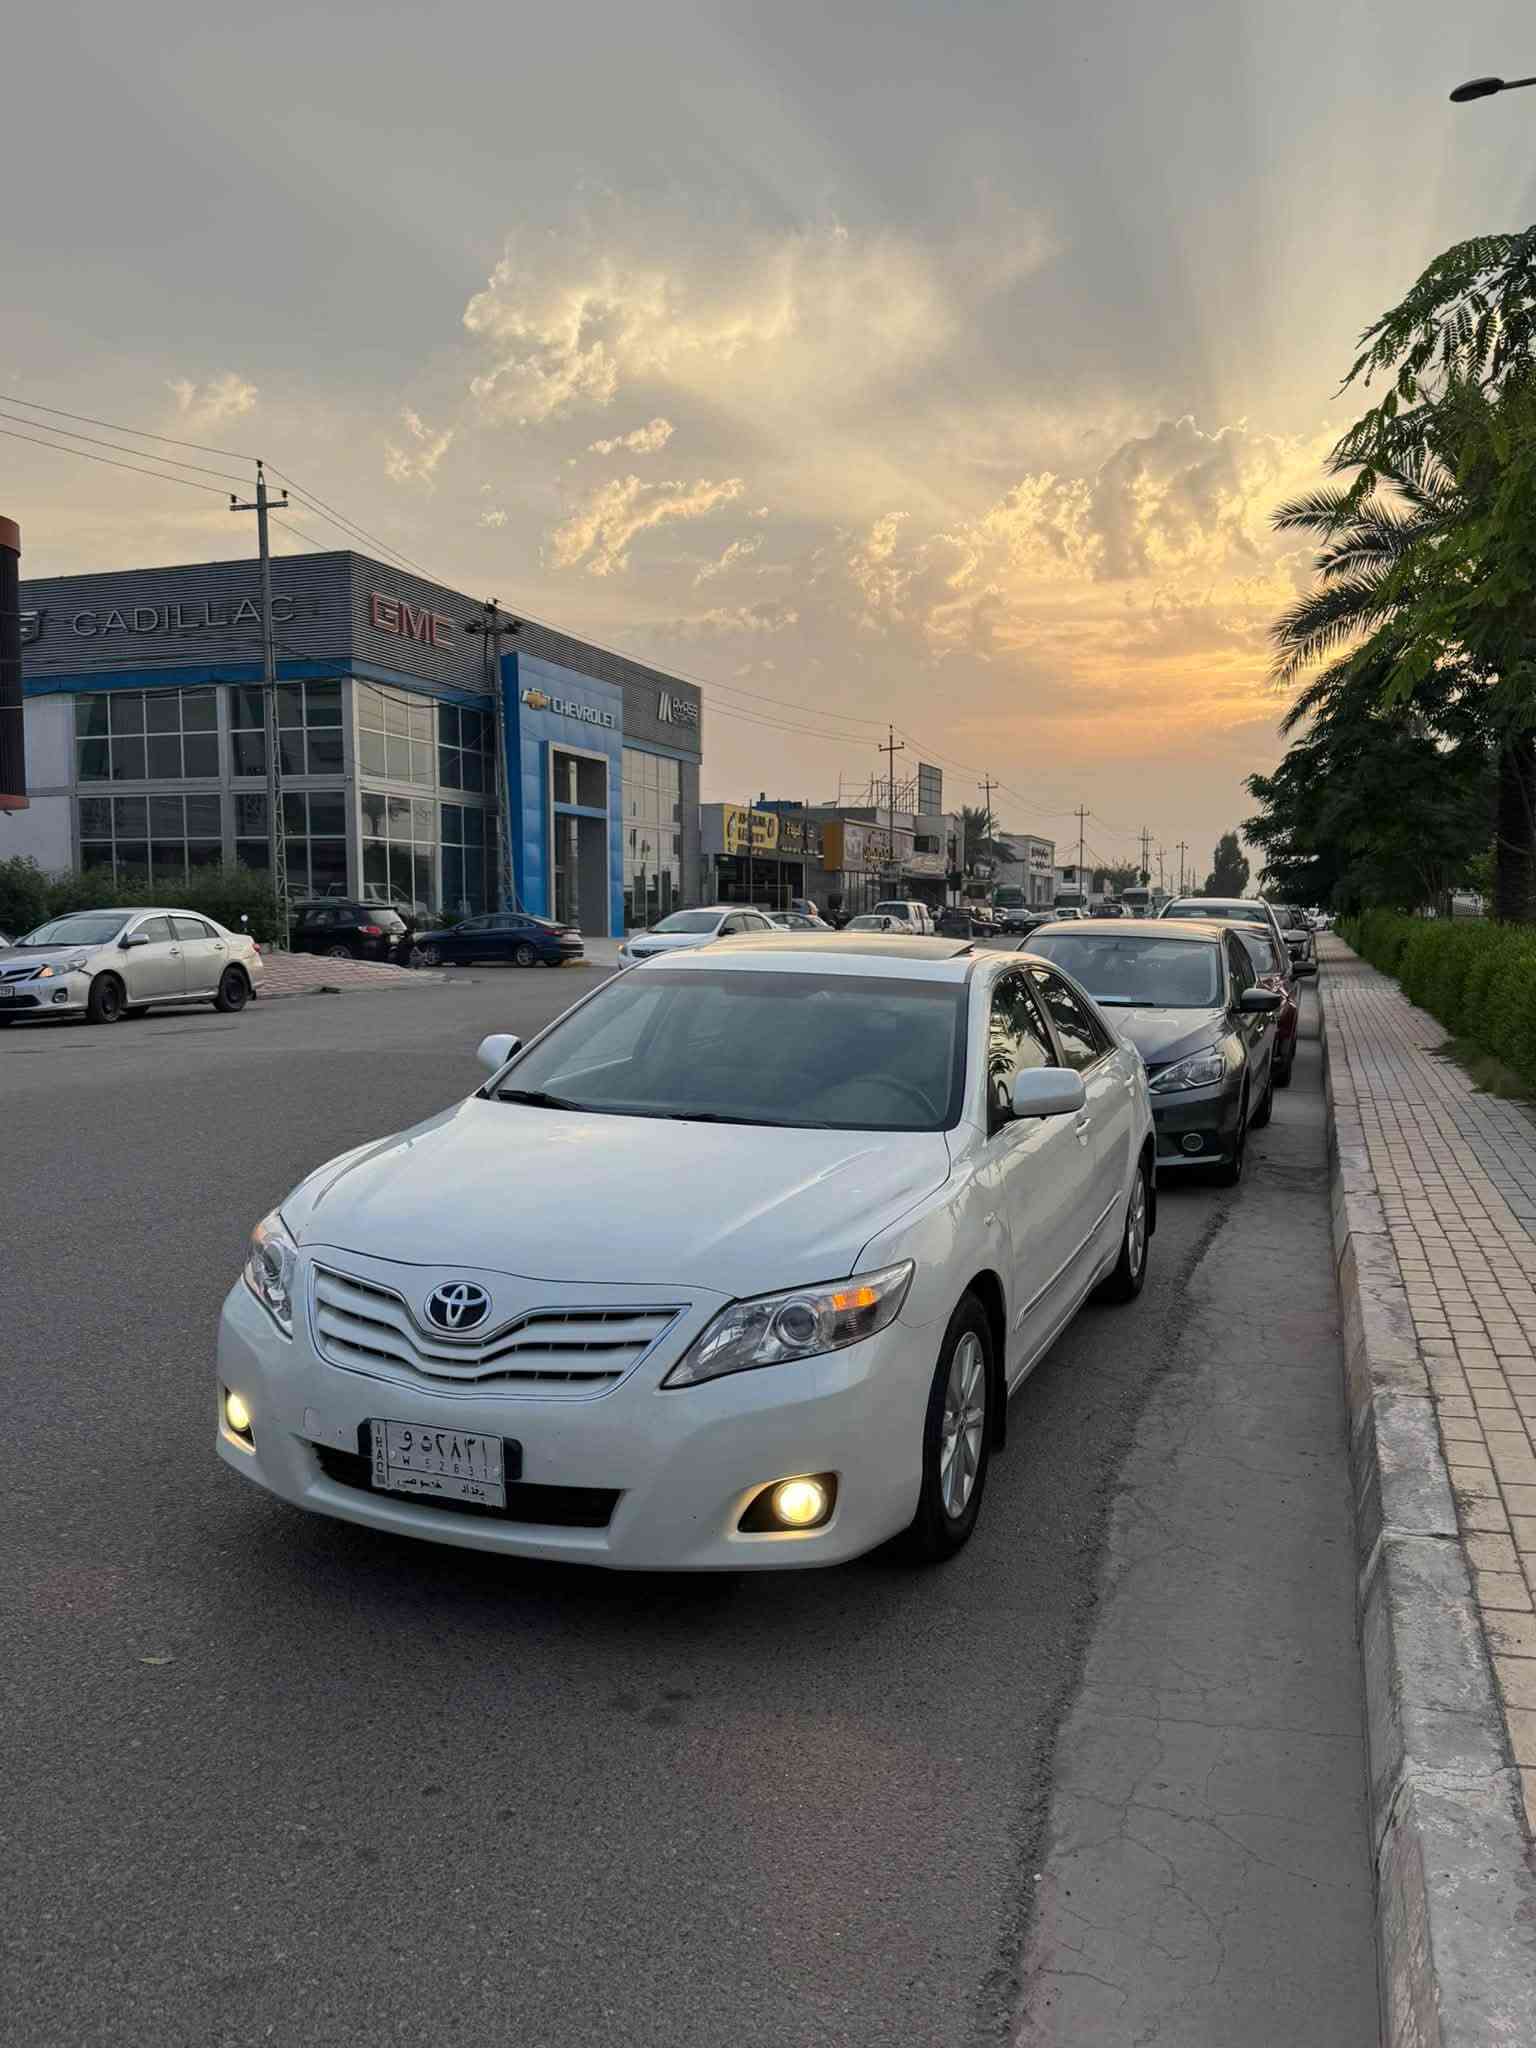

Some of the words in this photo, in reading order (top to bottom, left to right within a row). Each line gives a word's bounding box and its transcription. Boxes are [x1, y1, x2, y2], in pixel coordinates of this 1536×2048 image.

[72, 596, 294, 636] CADILLAC
[371, 592, 457, 648] GMC
[552, 697, 616, 729] CHEVROLET
